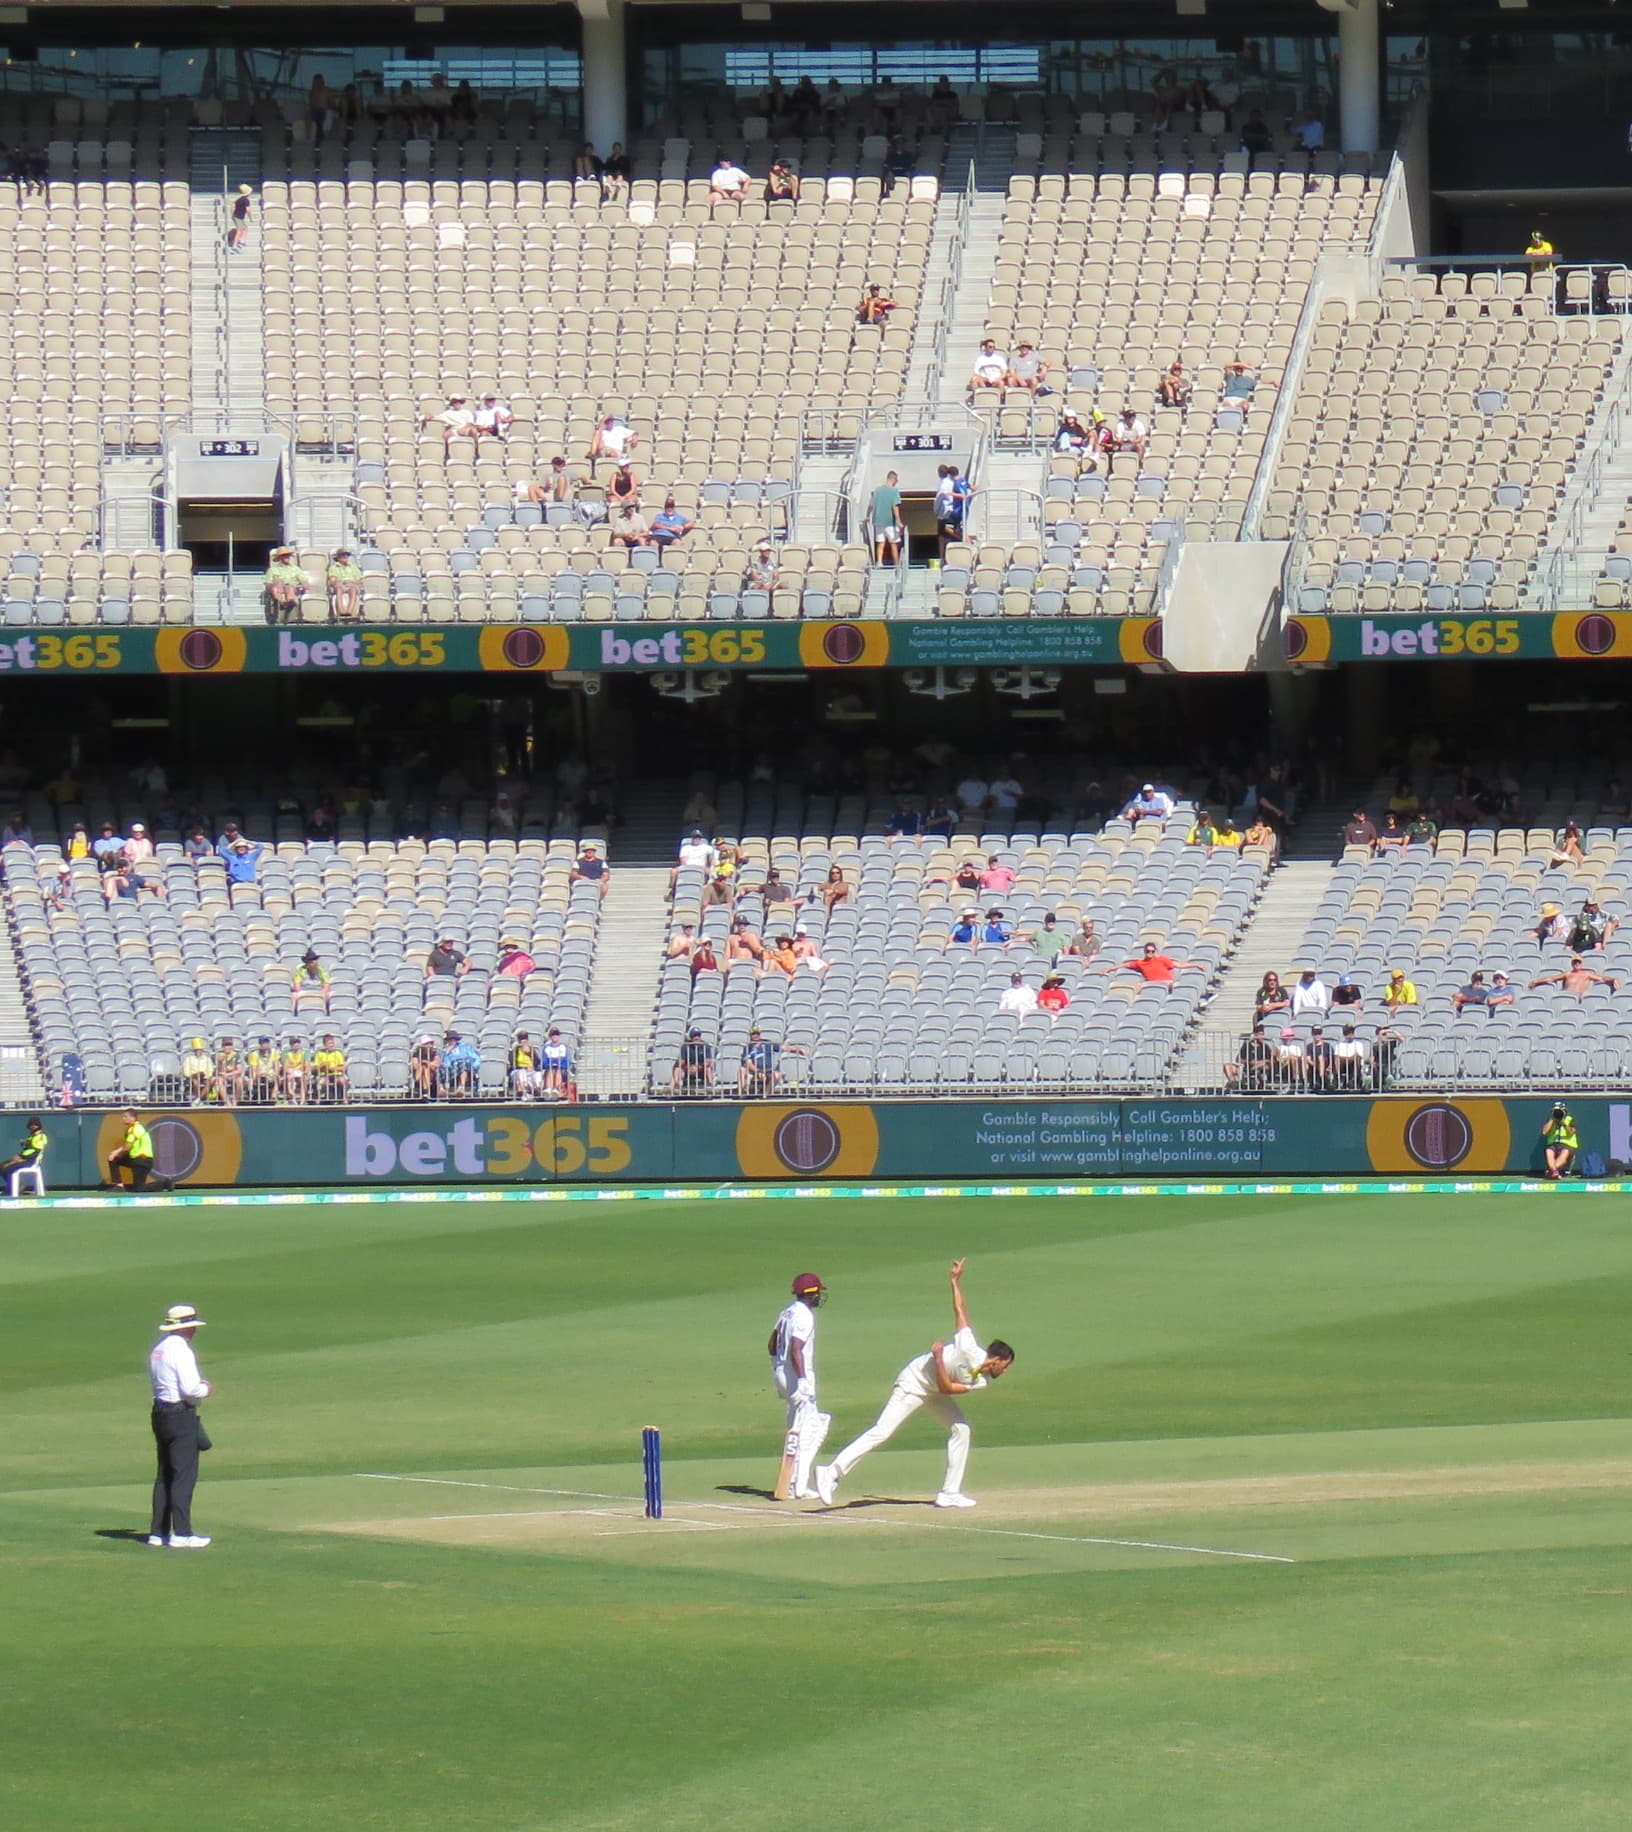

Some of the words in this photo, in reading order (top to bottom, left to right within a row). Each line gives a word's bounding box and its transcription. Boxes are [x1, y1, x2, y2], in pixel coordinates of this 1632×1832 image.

[278, 631, 445, 667] bet365
[601, 629, 766, 664] bet365
[1361, 620, 1520, 655] bet365
[982, 1112, 1037, 1126] Gamble
[1129, 1110, 1156, 1125] Call
[1160, 1110, 1228, 1125] Gambler's
[345, 1115, 632, 1176] bet365
[976, 1131, 1035, 1145] National
[1040, 1130, 1107, 1146] Gambling
[1179, 1129, 1213, 1143] 1800
[1218, 1129, 1244, 1143] 858
[1248, 1129, 1276, 1142] 858
[990, 1152, 1006, 1163] or
[1009, 1149, 1036, 1163] visit
